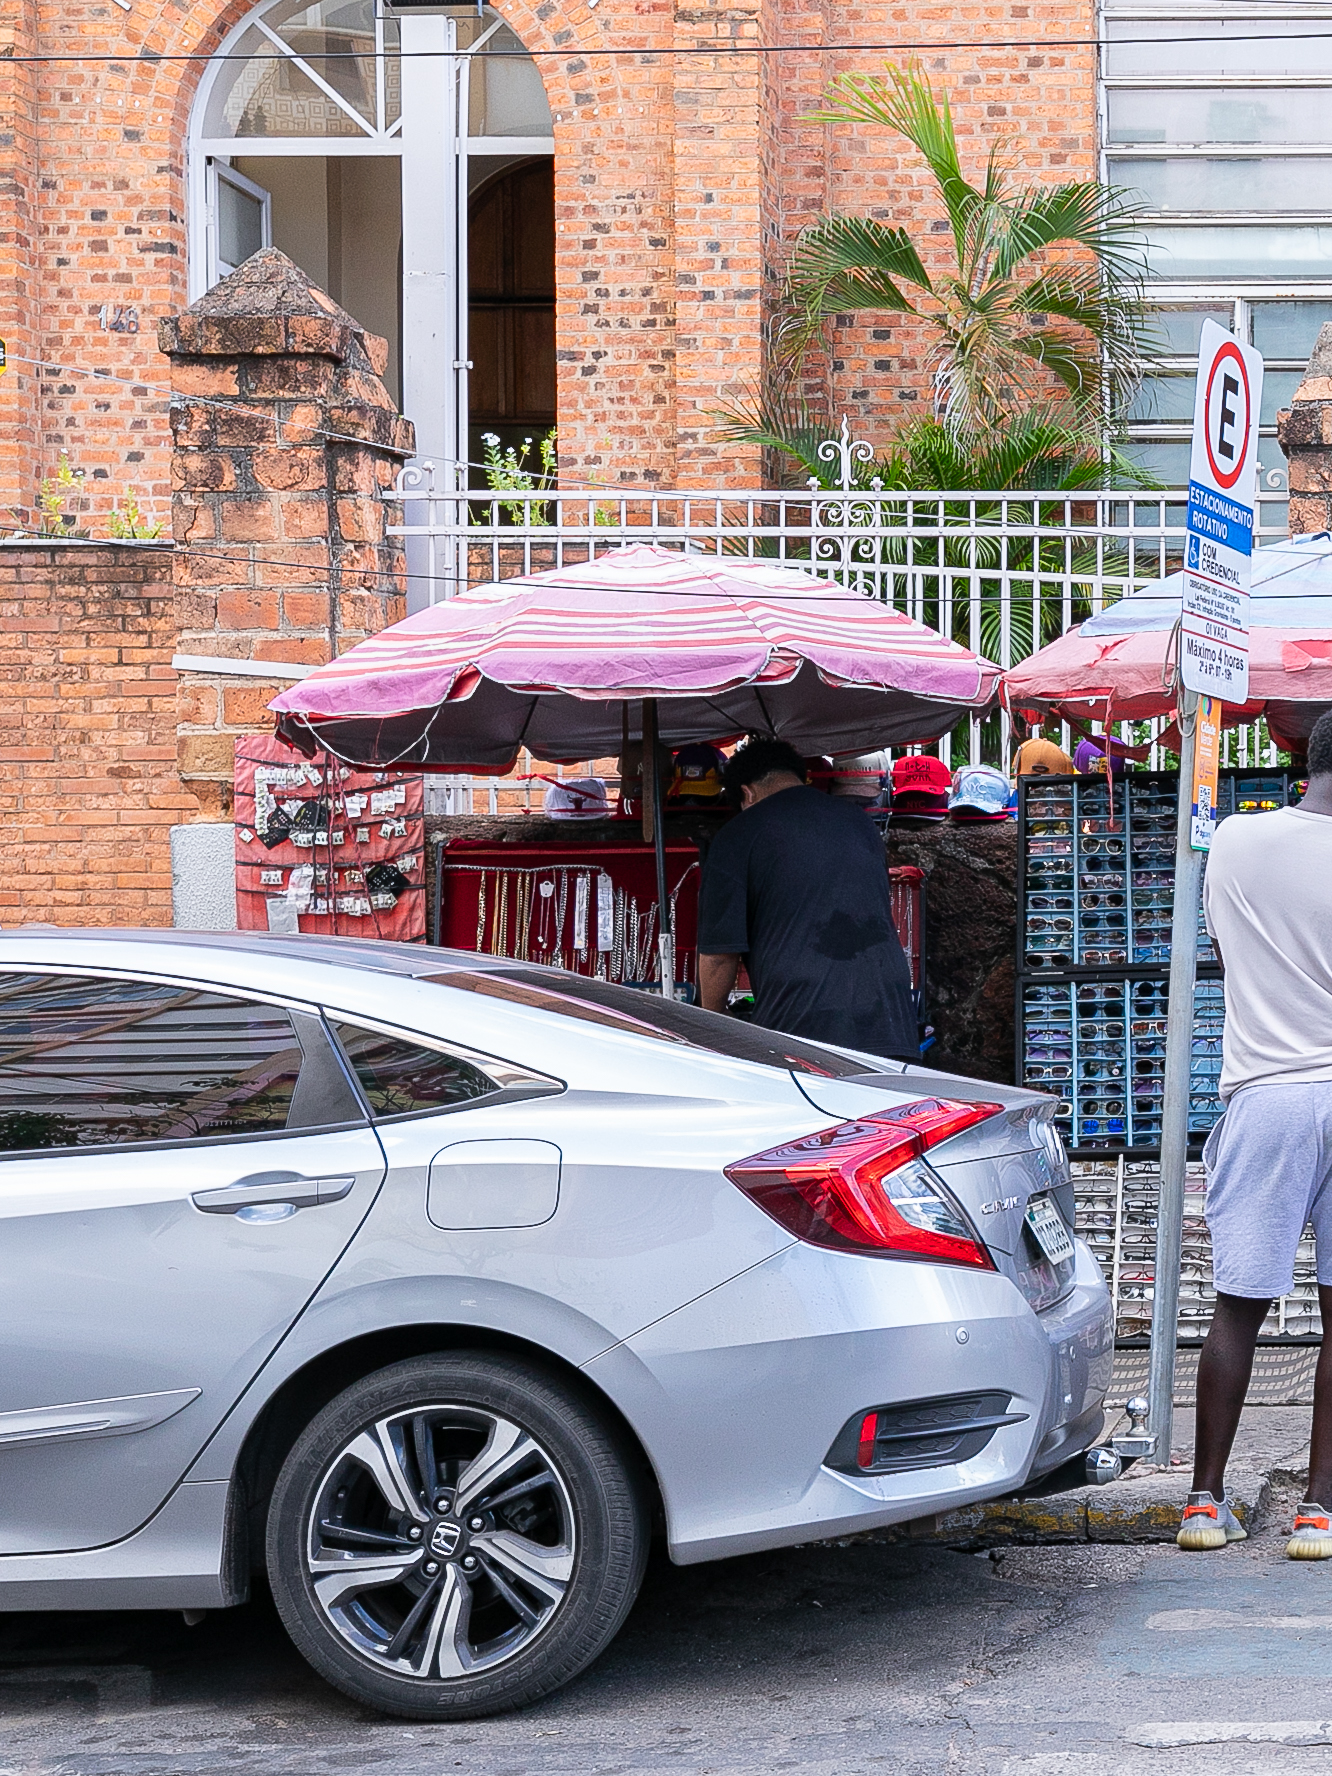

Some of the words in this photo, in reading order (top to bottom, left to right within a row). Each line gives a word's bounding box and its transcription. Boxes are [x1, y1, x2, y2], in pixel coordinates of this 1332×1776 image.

[97, 305, 139, 333] 148
[1218, 373, 1239, 461] E
[1190, 486, 1252, 528] ESTACIONAMENTO
[1192, 511, 1228, 539] ROTATIVO
[1202, 543, 1217, 560] COM
[1202, 558, 1240, 585] CREDENCIAL
[1187, 638, 1217, 662] Máximo
[1217, 648, 1222, 664] 4
[1224, 650, 1244, 671] horas
[906, 800, 926, 808] NYC
